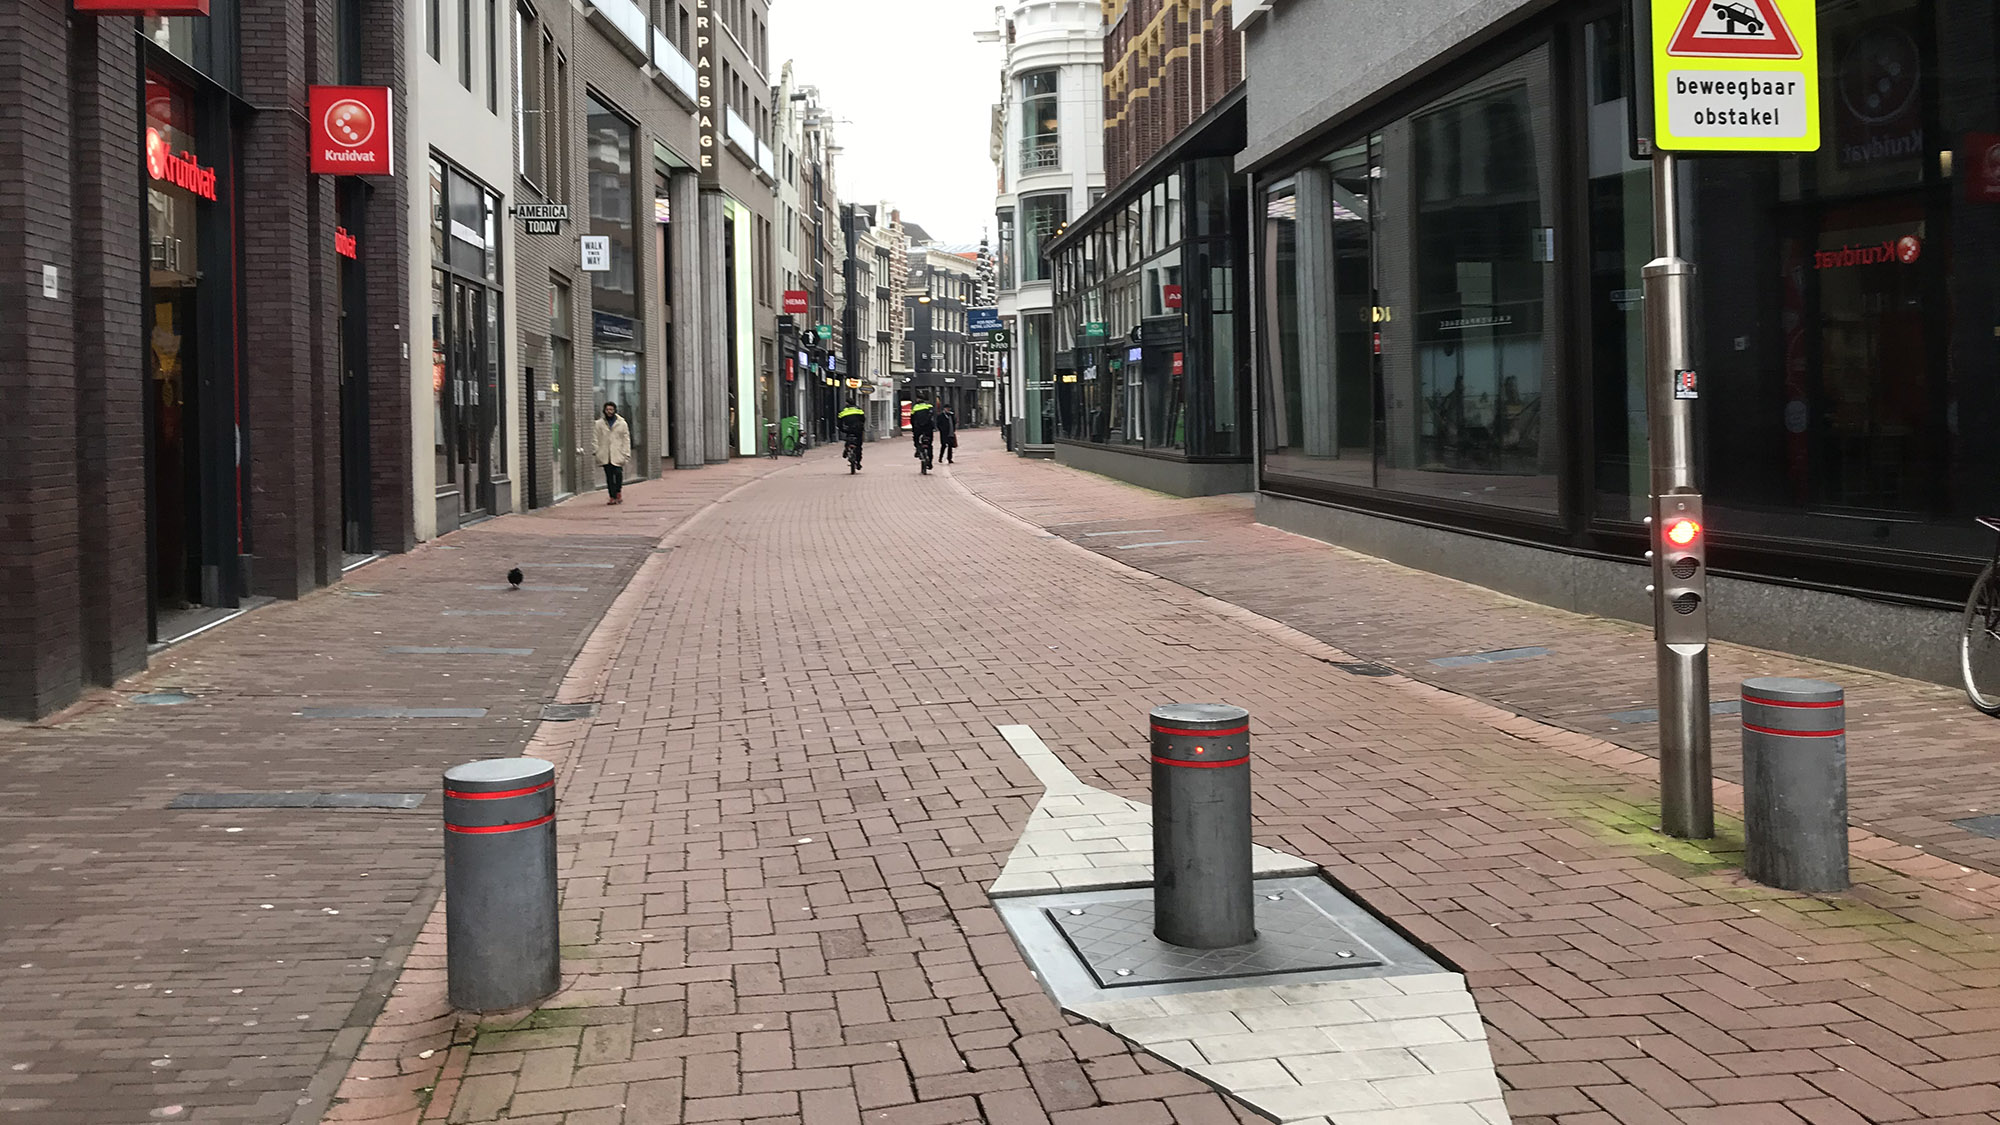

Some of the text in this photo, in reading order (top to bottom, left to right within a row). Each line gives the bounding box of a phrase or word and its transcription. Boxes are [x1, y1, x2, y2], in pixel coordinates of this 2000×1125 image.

[1676, 76, 1796, 100] beweegbaar
[1693, 107, 1779, 125] obstakel
[325, 149, 375, 162] Kruidvat
[518, 206, 566, 218] AMERICA
[527, 221, 557, 233] TODAY
[585, 242, 602, 250] WALK
[587, 257, 601, 265] WAY
[785, 298, 807, 306] HEMA
